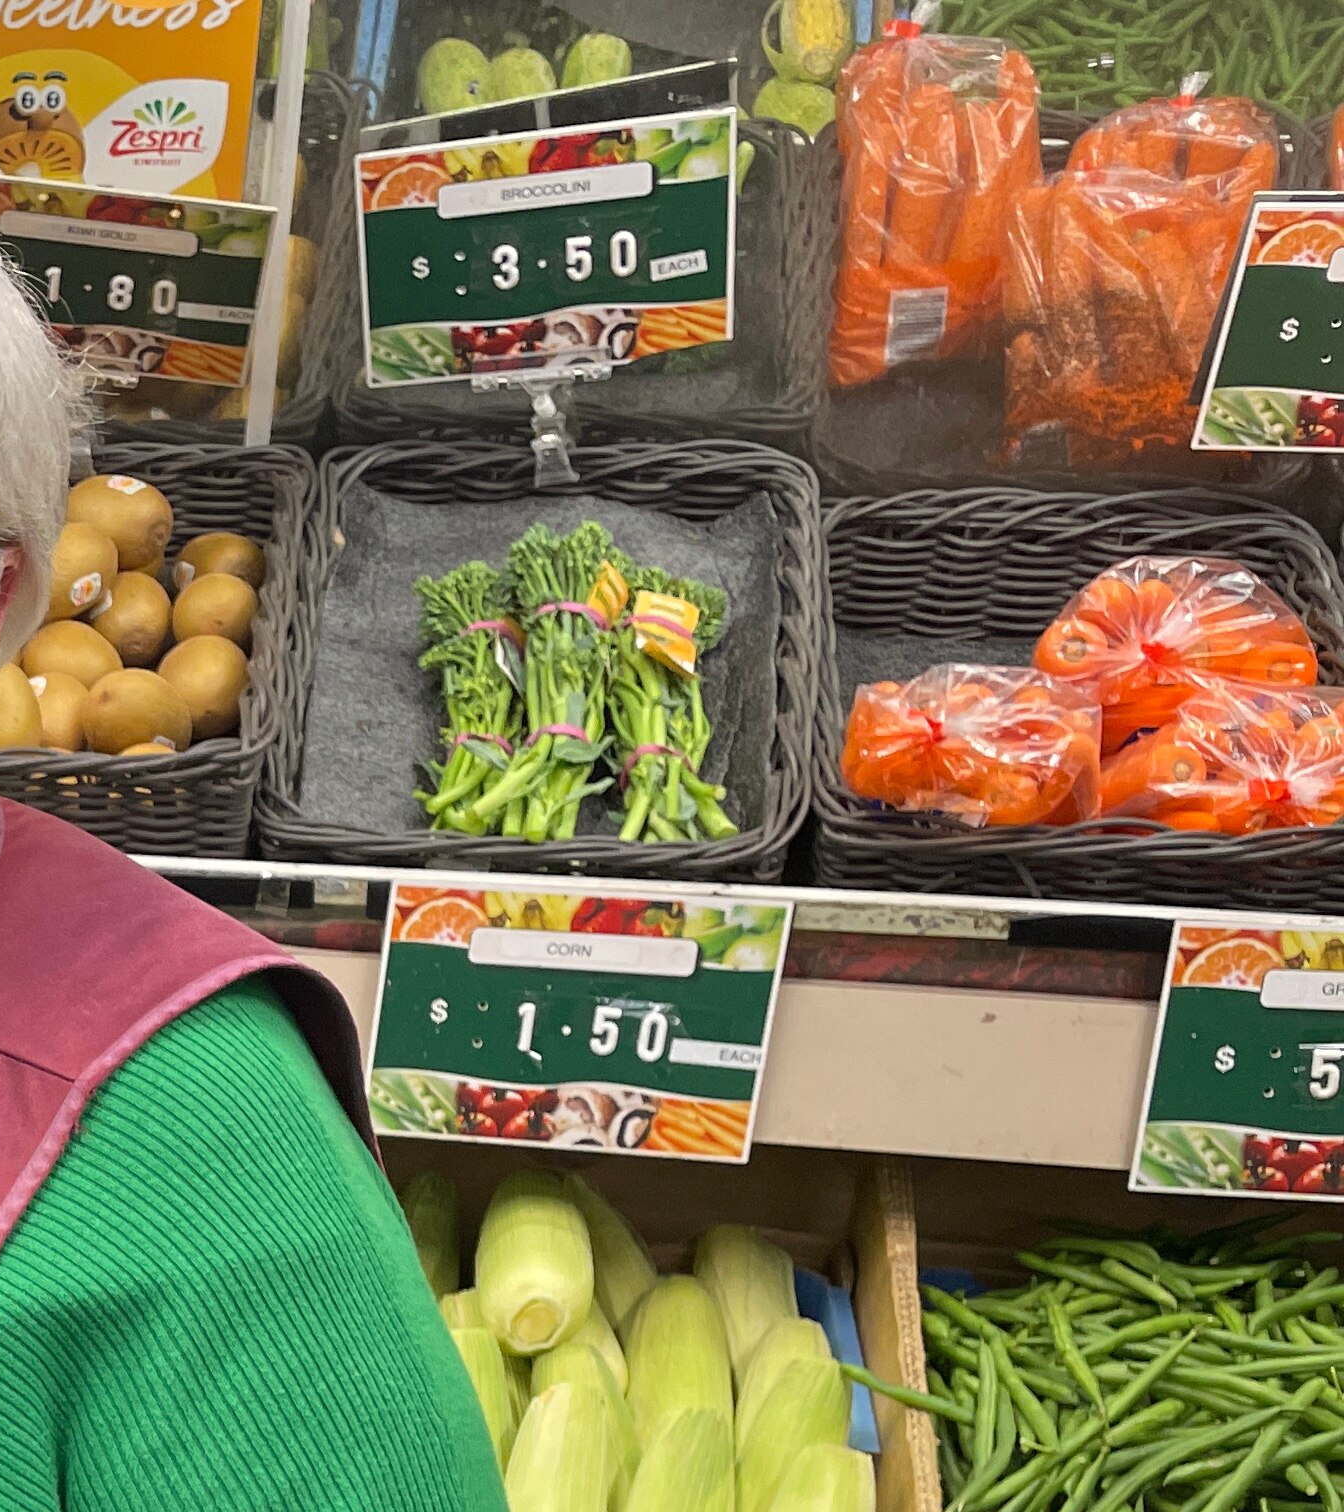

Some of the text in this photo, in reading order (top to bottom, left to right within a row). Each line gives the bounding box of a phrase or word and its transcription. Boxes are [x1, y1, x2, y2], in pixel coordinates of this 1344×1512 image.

[109, 119, 207, 156] Zespri
[501, 179, 592, 201] BROCCOLINI
[67, 225, 136, 242] KIWI GOLD
[411, 229, 700, 290] $ 3.50 EACH
[1279, 316, 1301, 342] $
[546, 942, 593, 958] CORN
[430, 997, 761, 1065] $ 1.50 EACH
[1214, 1044, 1236, 1074] $
